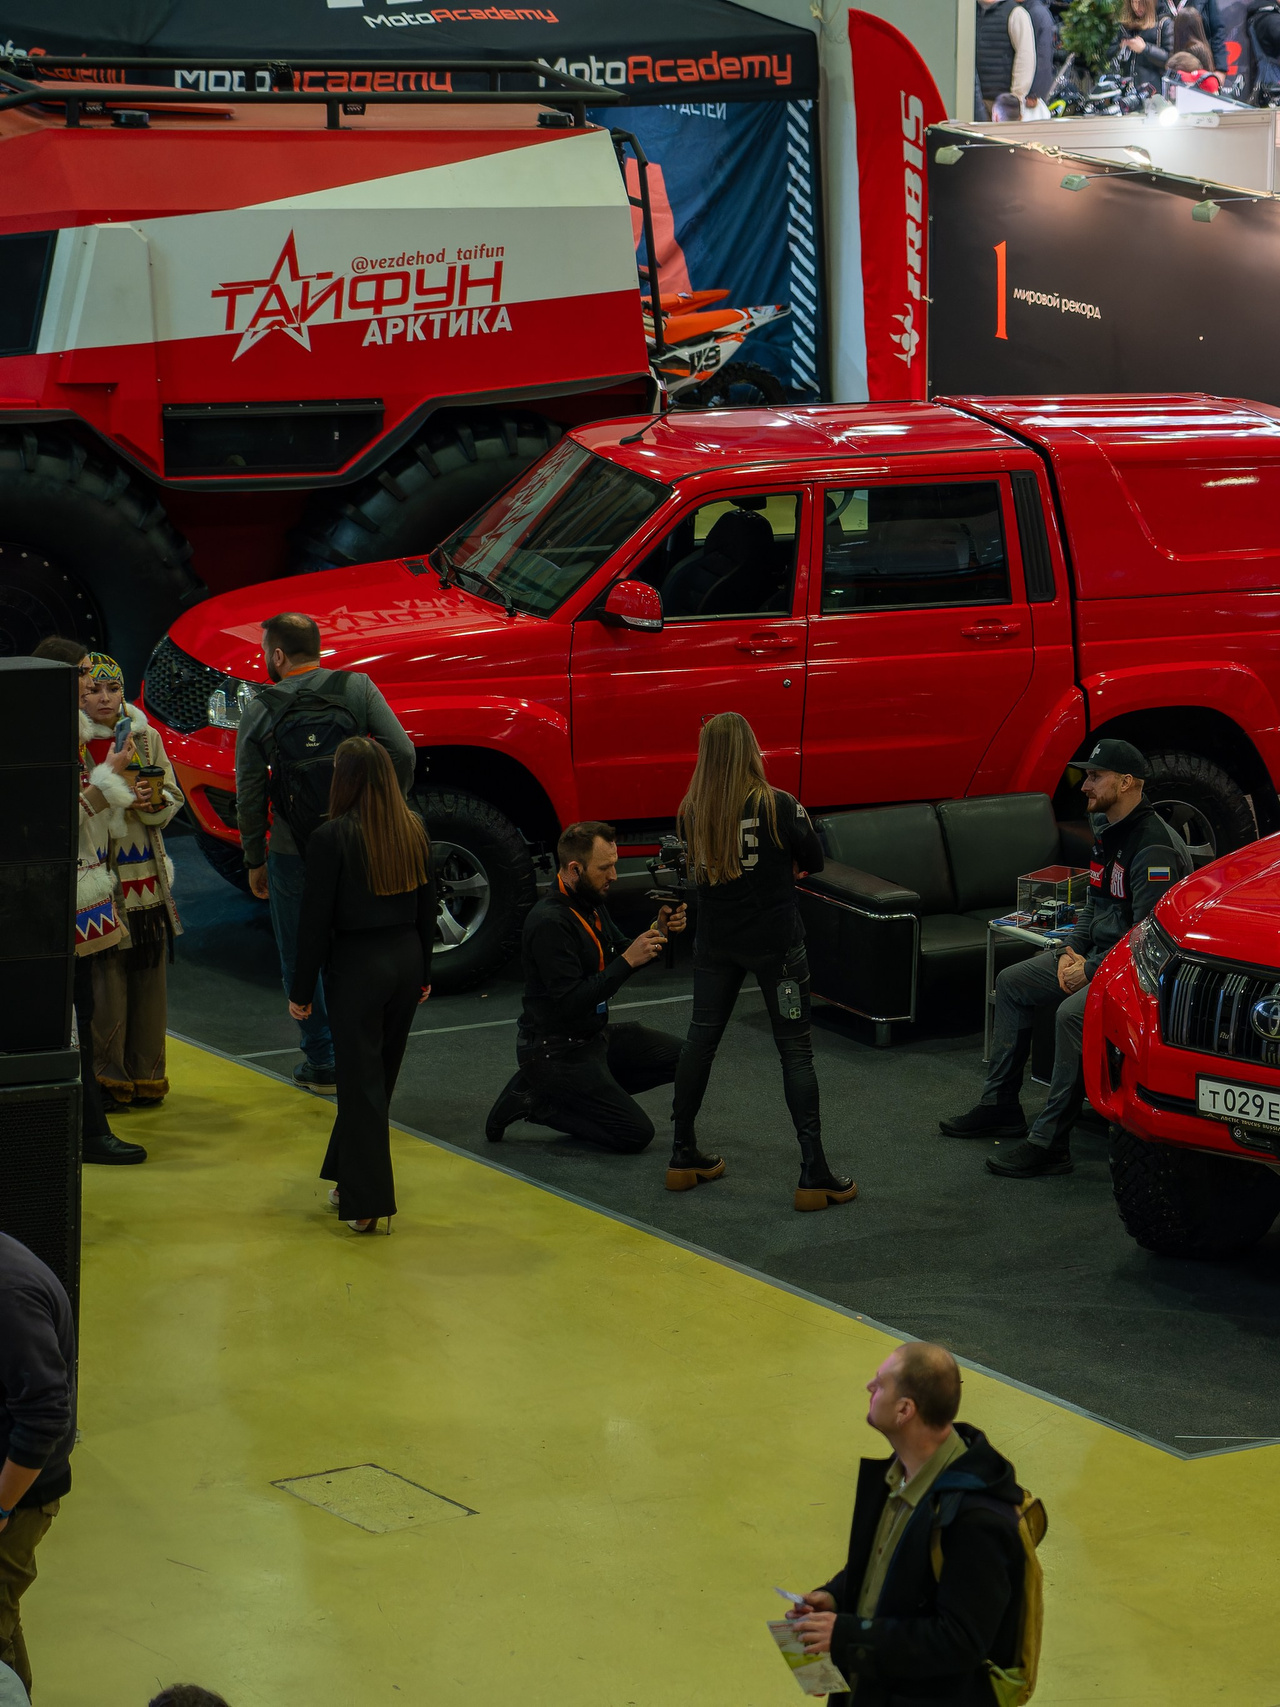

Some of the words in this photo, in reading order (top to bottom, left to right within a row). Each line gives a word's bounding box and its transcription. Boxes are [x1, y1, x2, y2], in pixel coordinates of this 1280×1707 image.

[363, 7, 559, 29] MotoAcademy
[901, 90, 924, 301] IRBIS
[351, 244, 505, 274] @vezdehod_taifun
[211, 257, 504, 333] ТАЙФУН
[993, 241, 1008, 341] 1
[1013, 288, 1060, 309] мировой
[1061, 298, 1102, 320] рекорд
[361, 305, 513, 348] АРКТИКА
[1220, 1115, 1240, 1124] ARCTIC
